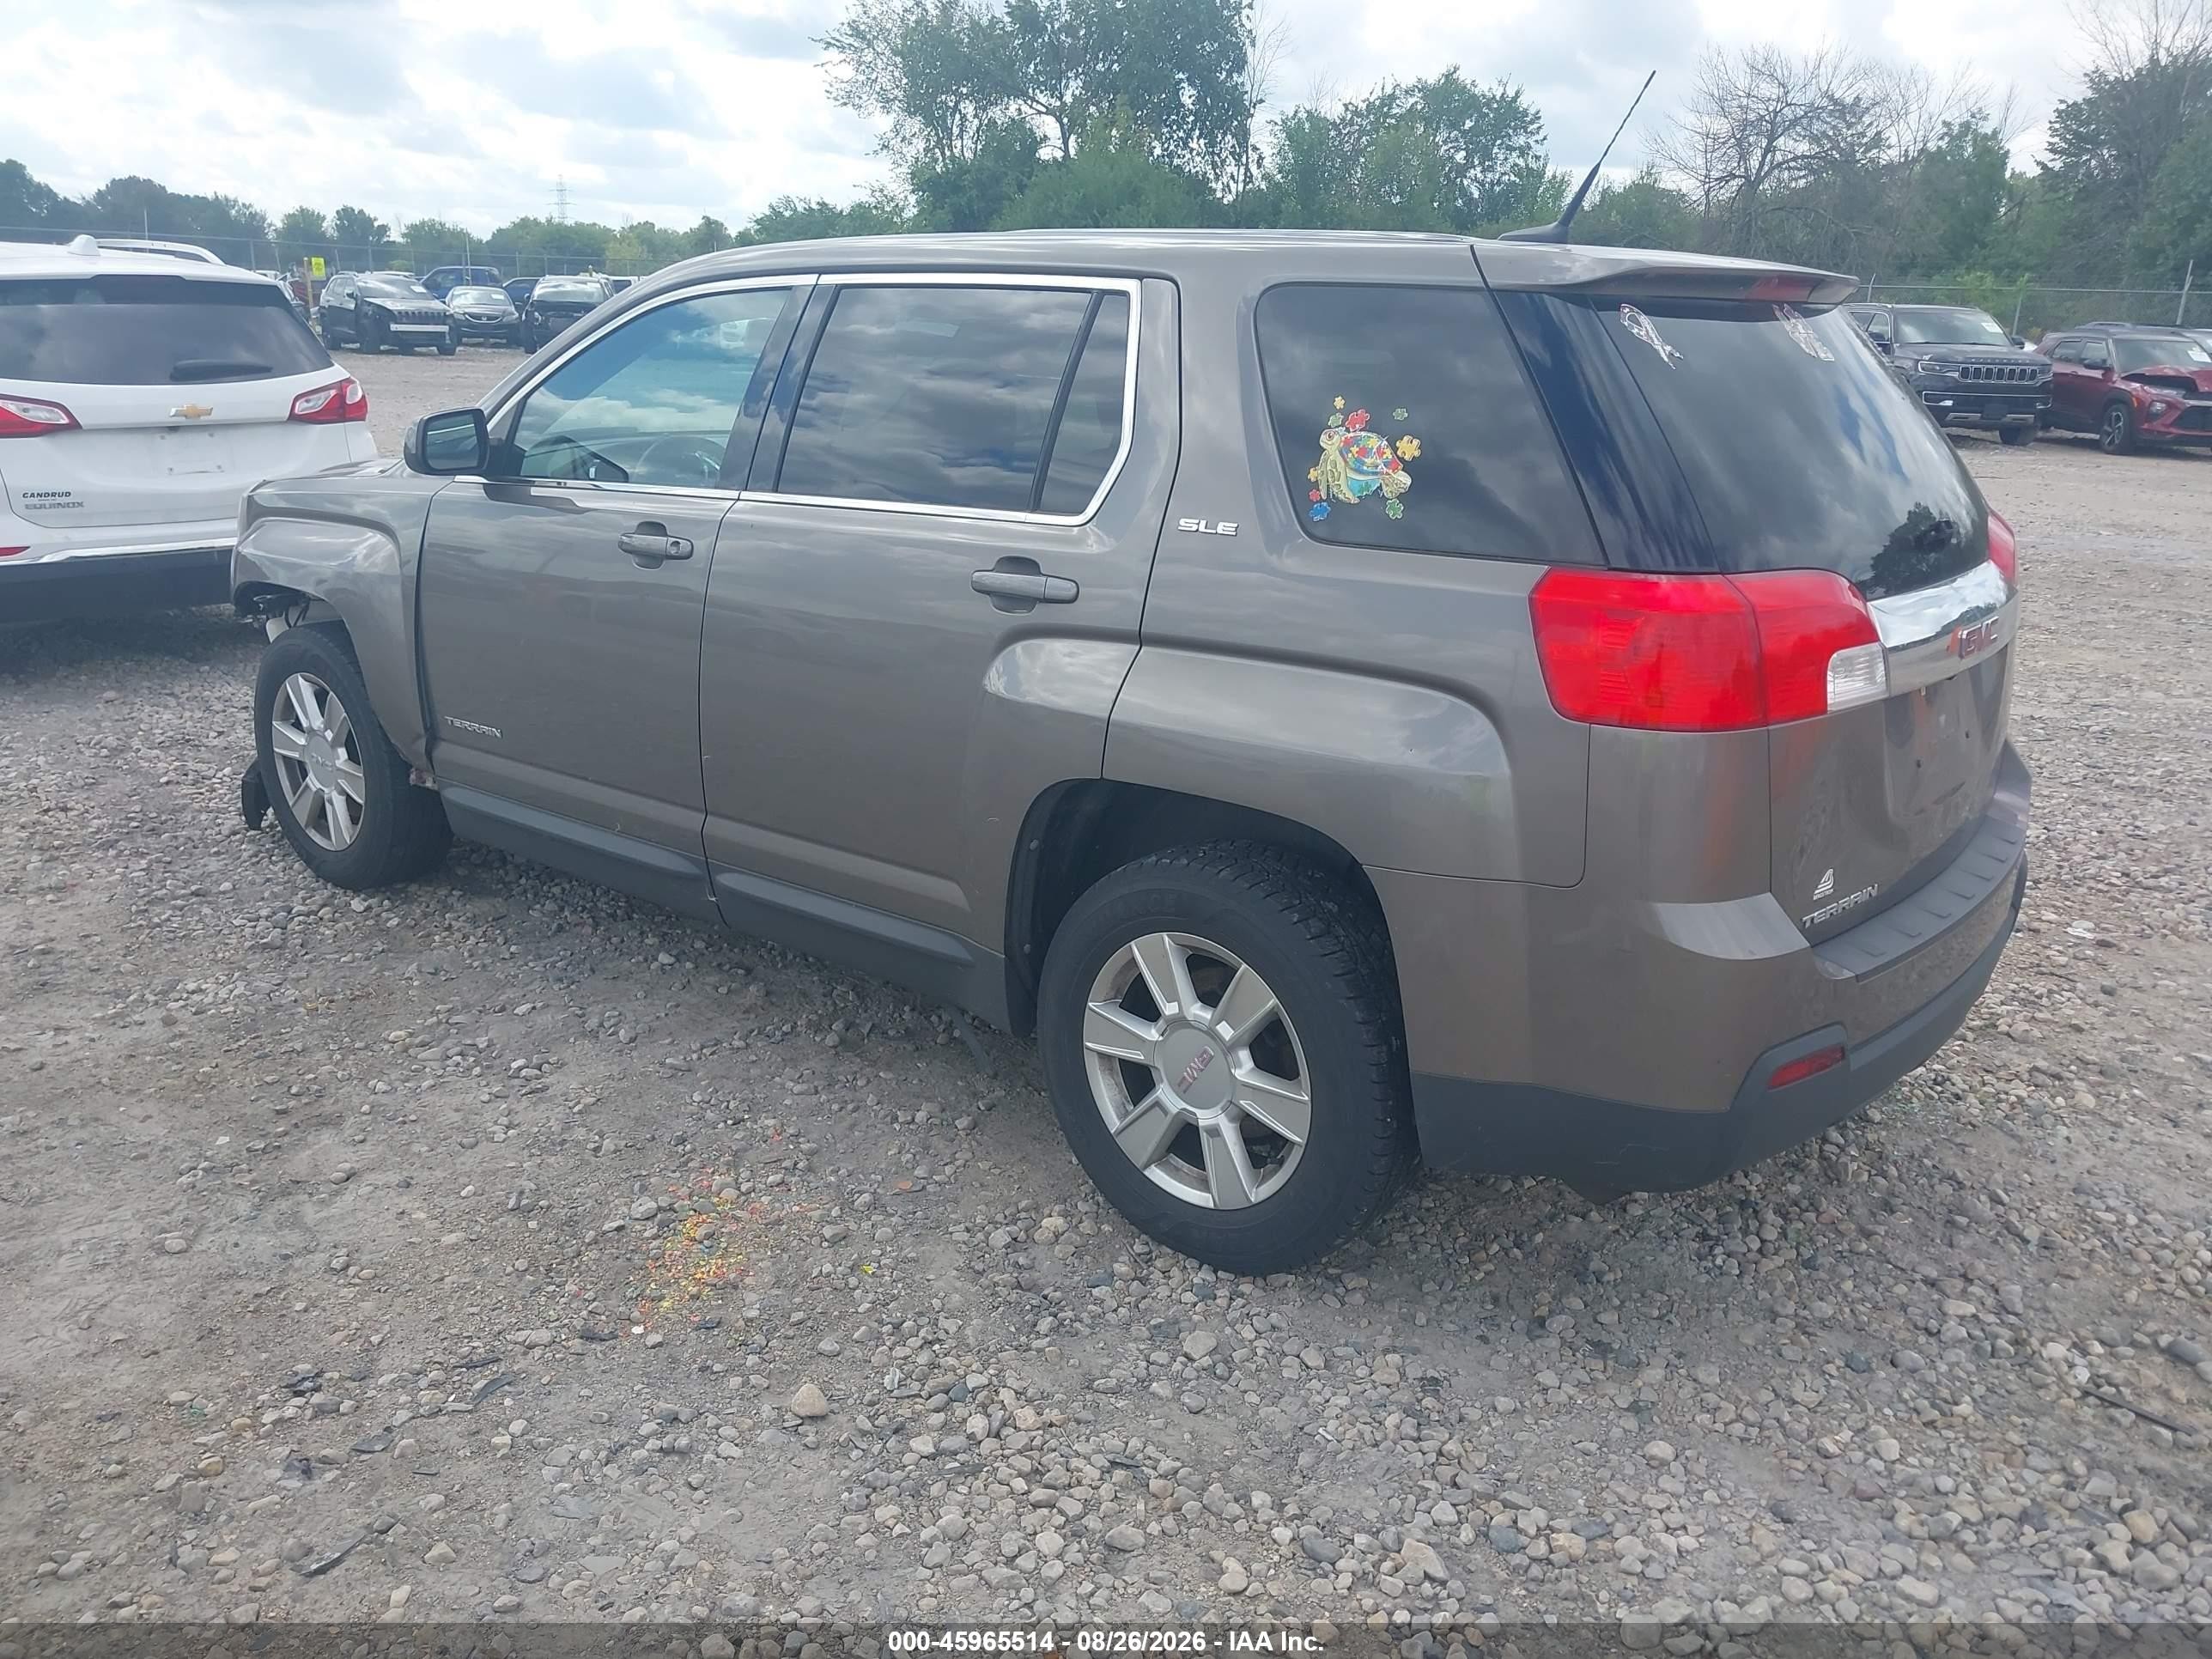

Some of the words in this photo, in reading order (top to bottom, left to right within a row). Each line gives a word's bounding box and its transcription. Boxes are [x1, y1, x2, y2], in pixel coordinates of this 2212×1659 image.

[1177, 518, 1238, 536] SLE
[444, 715, 502, 738] TERRAIN
[1802, 884, 1879, 928] TERRAIN
